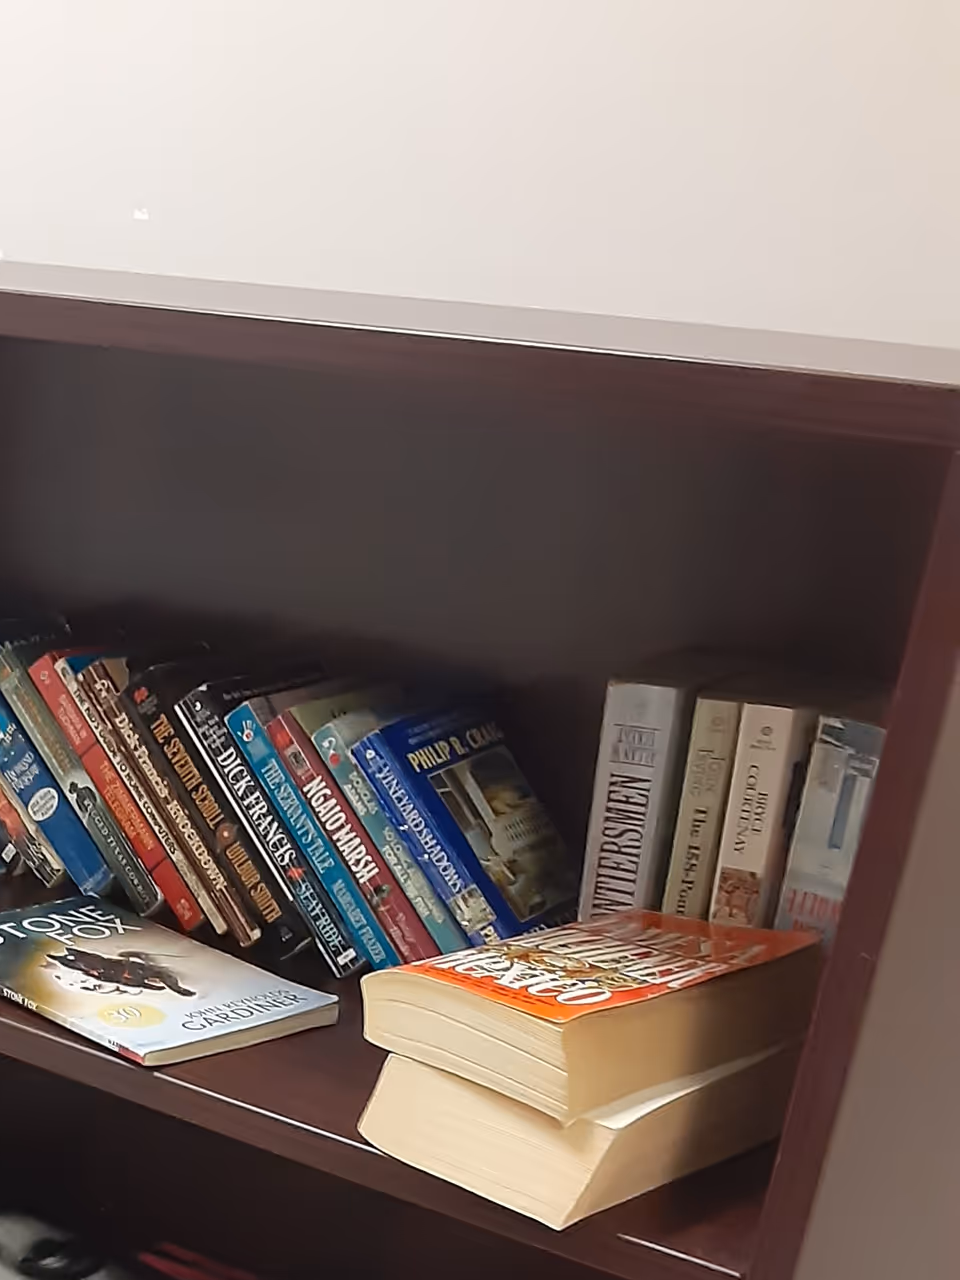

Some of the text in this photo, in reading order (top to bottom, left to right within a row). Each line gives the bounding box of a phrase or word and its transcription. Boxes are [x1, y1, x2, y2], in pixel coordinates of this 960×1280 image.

[150, 713, 225, 829] THE SEVENTH SCROLL
[407, 740, 451, 772] PHILIP
[116, 712, 139, 749] Dick
[136, 744, 170, 798] Francis
[168, 800, 227, 890] KNOCKDOWN
[218, 747, 296, 867] DICK FRANCIS
[260, 758, 285, 790] THE
[307, 837, 335, 874] TALE
[302, 775, 380, 884] NGAIO MARSH
[377, 765, 462, 894] VINEYARD SHADOWS
[690, 807, 707, 838] The
[734, 764, 760, 854] COURTENAY
[751, 791, 769, 834] BRYCE
[226, 842, 281, 923] WILBUR SMITH
[590, 773, 652, 918] NTIERSMEN
[46, 915, 143, 946] FOX
[358, 925, 387, 966] FRAZER
[181, 993, 307, 1031] GARDINER
[184, 990, 290, 1019] JOHN REYNOLDS
